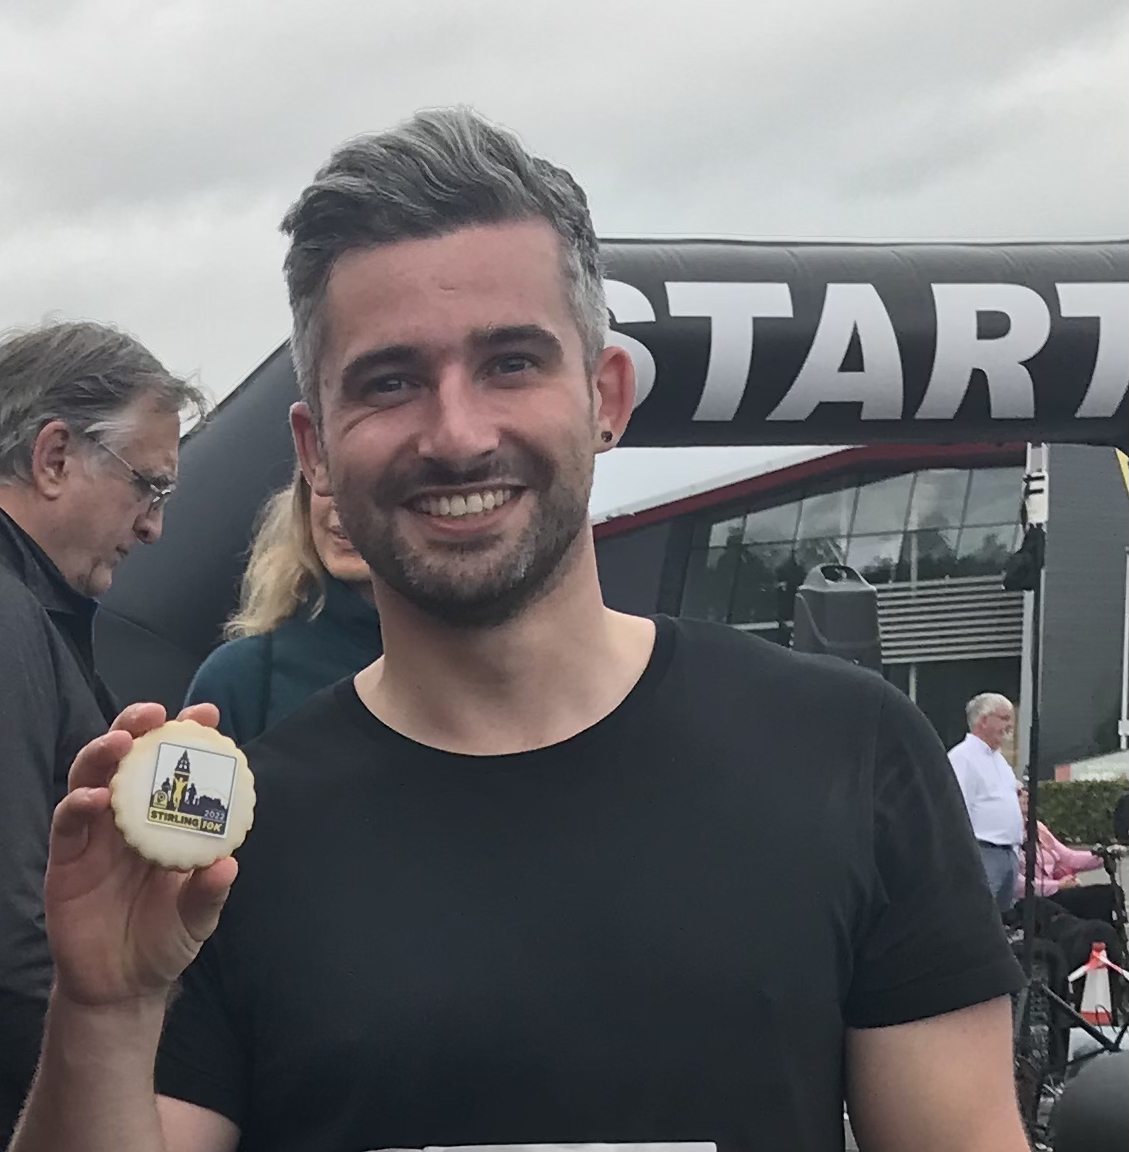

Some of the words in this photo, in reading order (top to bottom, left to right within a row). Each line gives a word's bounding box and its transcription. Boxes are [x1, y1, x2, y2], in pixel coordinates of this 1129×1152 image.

[150, 810, 199, 827] STIRLING
[201, 820, 223, 832] 10K
[203, 810, 225, 821] 2022
